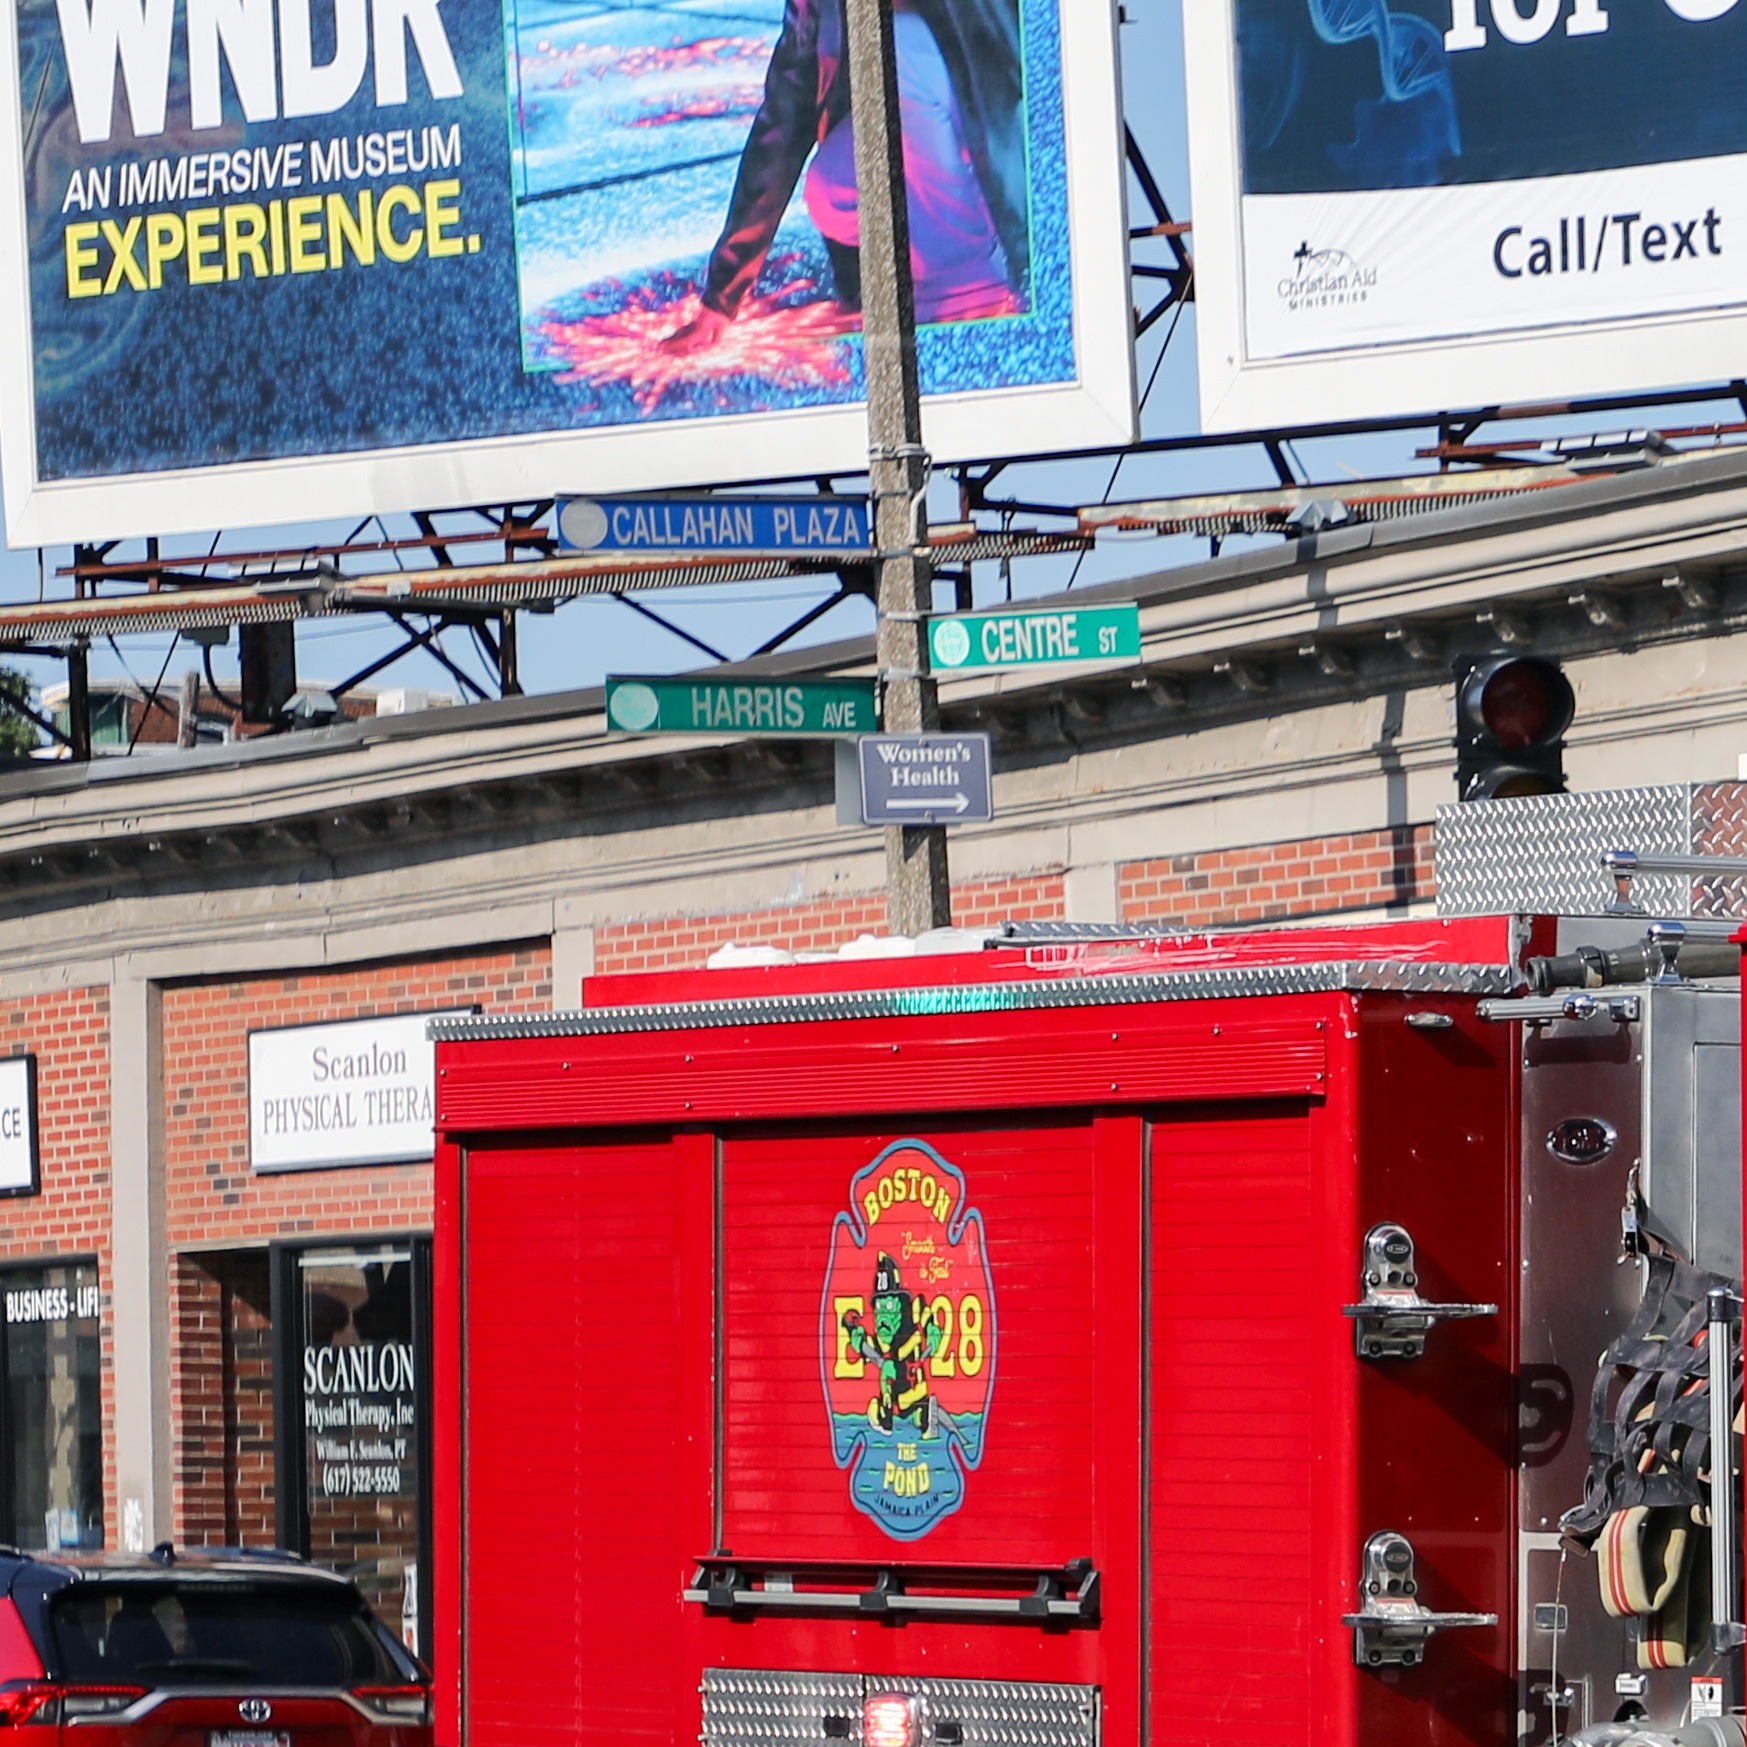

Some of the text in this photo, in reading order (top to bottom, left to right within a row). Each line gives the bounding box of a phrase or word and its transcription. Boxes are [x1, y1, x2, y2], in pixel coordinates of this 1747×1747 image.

[62, 125, 463, 213] AN IMMERSIVE MUSEUM
[63, 178, 481, 300] EXPERIENCE.
[1493, 207, 1723, 279] Call/Text
[1277, 265, 1378, 298] Christian Aid
[612, 505, 860, 547] CALLAHAN PLAZA
[980, 612, 1119, 664] CENTRE ST
[692, 686, 857, 729] HARRIS AVE
[876, 741, 971, 764] Women's
[890, 764, 960, 787] Health
[312, 1040, 407, 1083] Scanlon
[263, 1084, 434, 1136] PHYSICAL THERA
[864, 1167, 951, 1227] BOSTON
[6, 1287, 69, 1323] BUSINESS
[930, 1295, 985, 1378] 28
[303, 1343, 415, 1395] SCANLON
[305, 1397, 347, 1433] Physical
[897, 1442, 918, 1462] THE
[322, 1462, 400, 1497] (617) 522-5550
[883, 1460, 931, 1497] POND
